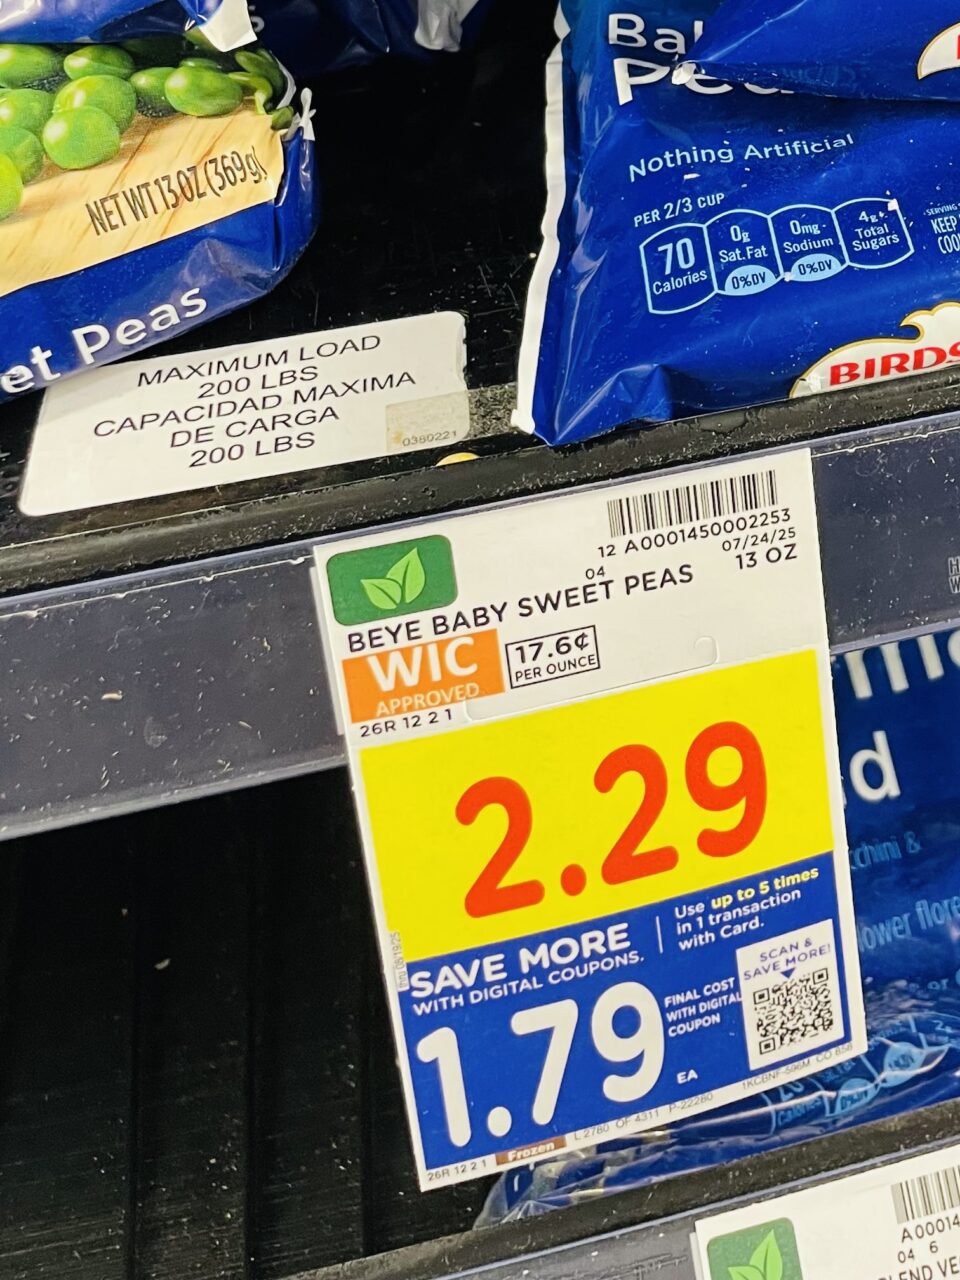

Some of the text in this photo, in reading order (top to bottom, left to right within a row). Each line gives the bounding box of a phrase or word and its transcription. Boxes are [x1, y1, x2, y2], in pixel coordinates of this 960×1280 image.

[628, 133, 855, 184] Nothing Artificial
[85, 144, 268, 237] NET WT 13 OZ (369g)
[633, 192, 726, 228] PER 2/3 CUP
[930, 215, 957, 235] KEEP
[783, 236, 834, 255] Sodium
[852, 234, 900, 253] Sugars
[854, 223, 890, 241] Total
[657, 237, 696, 276] 70
[652, 270, 709, 296] Calories
[137, 334, 382, 388] MAXIMUM LOAD
[198, 364, 320, 399] 200 LBS
[94, 370, 416, 438] CAPACIDAD MAXIMA
[170, 406, 340, 449] DE CARGA
[189, 431, 317, 468] 200 LBS
[598, 507, 792, 558] 12 A0001450002253
[585, 526, 797, 580] 04 07/24/25
[347, 543, 799, 654] BEYE BABY SWEET PEAS 13 OZ
[366, 635, 480, 694] WIC
[513, 632, 591, 665] 17.6¢
[514, 654, 598, 683] PER OUNCE
[375, 681, 480, 718] APPROVED
[360, 707, 453, 738] 26R 12 2 1
[455, 721, 769, 919] 2.29
[674, 867, 820, 920] Use up to 5 times
[676, 889, 802, 935] in 1 transaction
[678, 915, 765, 952] with Card.
[759, 937, 813, 963] SCAN &
[409, 922, 632, 999] SAVE MORE
[743, 942, 832, 982] SAVE MORE!
[413, 951, 646, 1017] WITH DIGITAL COUPONS.
[663, 976, 736, 1009] FINAL COST
[665, 993, 743, 1023] WITH DIGITAL
[668, 1013, 722, 1038] COUPON
[416, 980, 666, 1148] 1.79
[676, 1068, 699, 1085] EA
[507, 1140, 556, 1163] Frozen
[897, 1248, 916, 1264] 04
[929, 1241, 939, 1254] 6
